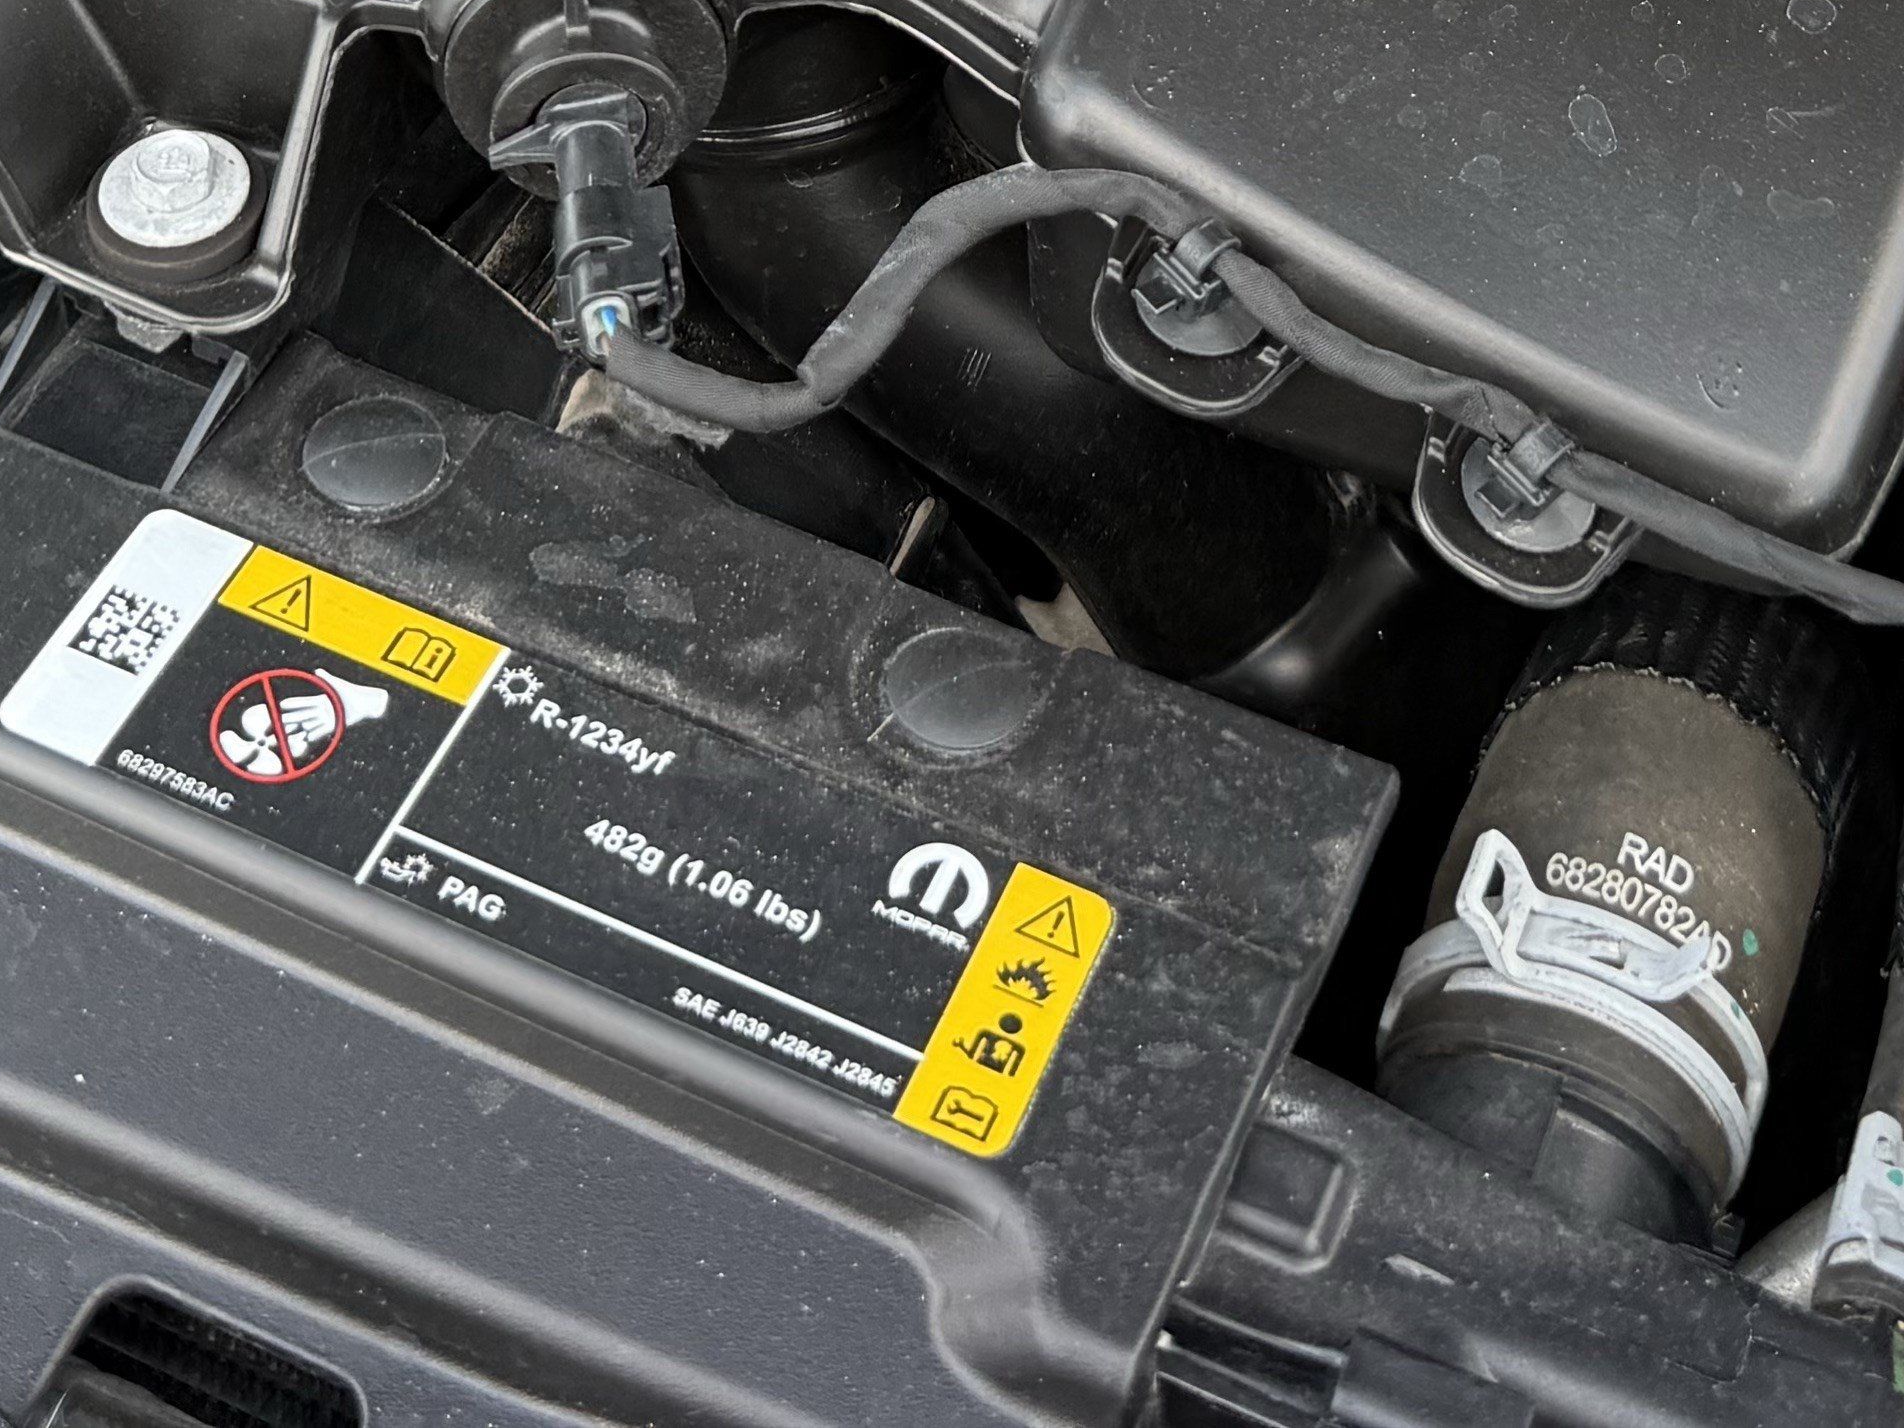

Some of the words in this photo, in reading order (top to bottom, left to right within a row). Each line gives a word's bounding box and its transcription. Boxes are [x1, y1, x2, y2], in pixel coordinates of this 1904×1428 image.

[528, 697, 676, 776] R-1234yf
[116, 748, 235, 812] 68297583AC
[583, 818, 666, 876] 482g
[667, 852, 754, 908] (1.06
[753, 888, 822, 943] lbs)
[1617, 831, 1695, 894] RAD
[436, 875, 507, 923] PAG
[870, 899, 971, 953] MOPAR
[671, 986, 723, 1022] SAE
[717, 1008, 772, 1044] J639
[769, 1030, 836, 1070] J2842
[833, 1058, 898, 1098] J2845
